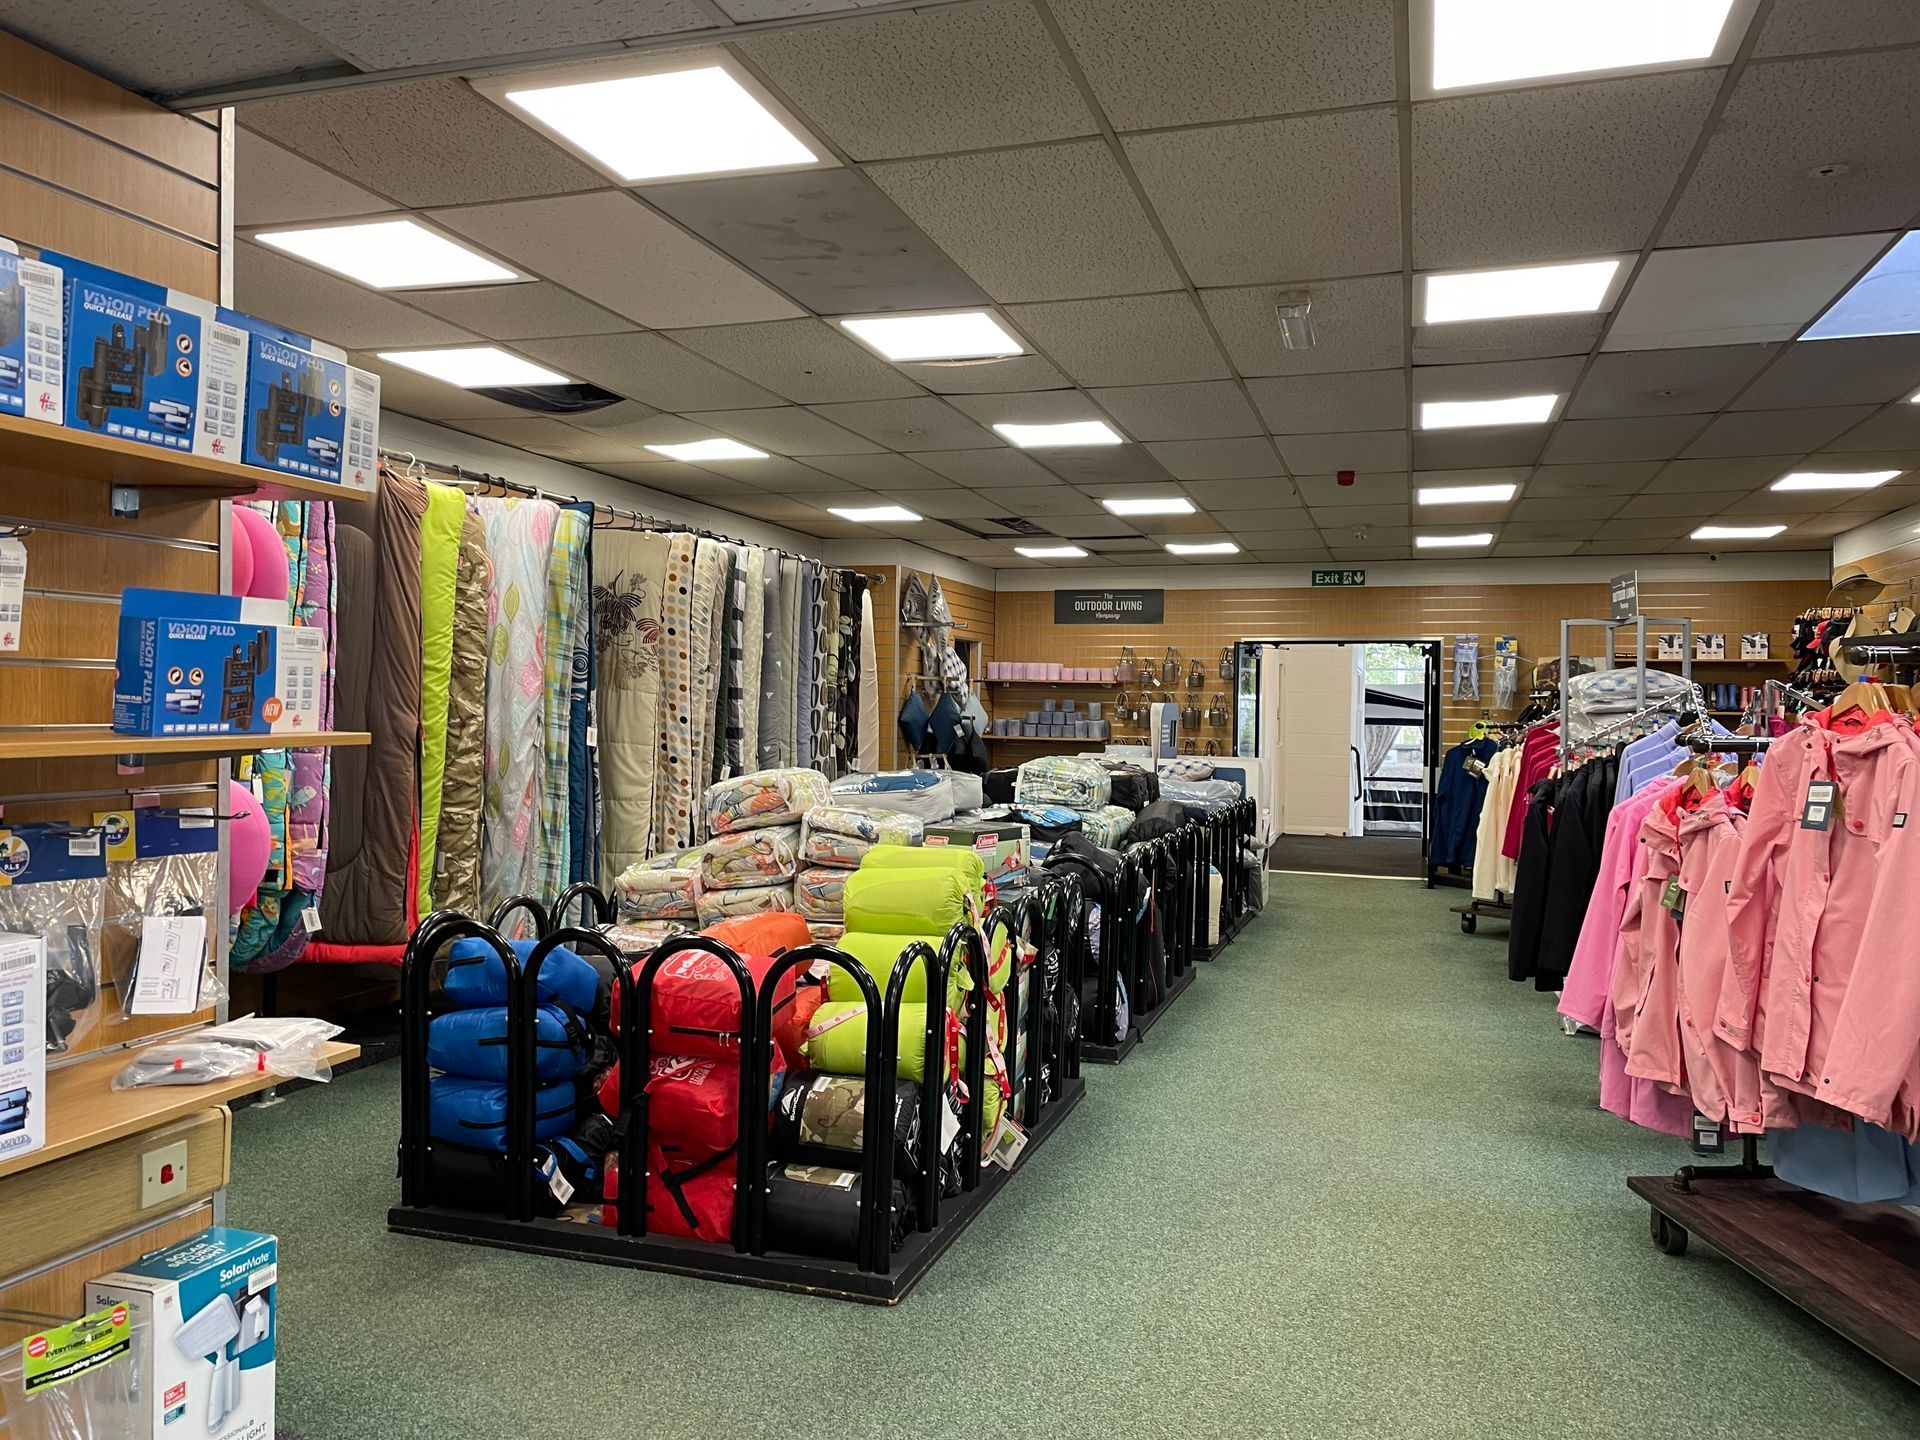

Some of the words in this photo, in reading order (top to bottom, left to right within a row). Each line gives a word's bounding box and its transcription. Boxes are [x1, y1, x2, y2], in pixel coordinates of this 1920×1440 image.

[83, 302, 105, 314] QUICK
[105, 307, 133, 322] RELEASE
[260, 352, 276, 363] QUICK
[1315, 573, 1340, 584] Exit
[1074, 601, 1113, 611] OUTDOOR
[1115, 600, 1143, 611] LIVING
[209, 624, 236, 637] PLUS
[264, 703, 281, 717] NEW
[219, 1253, 269, 1282] SolarMate
